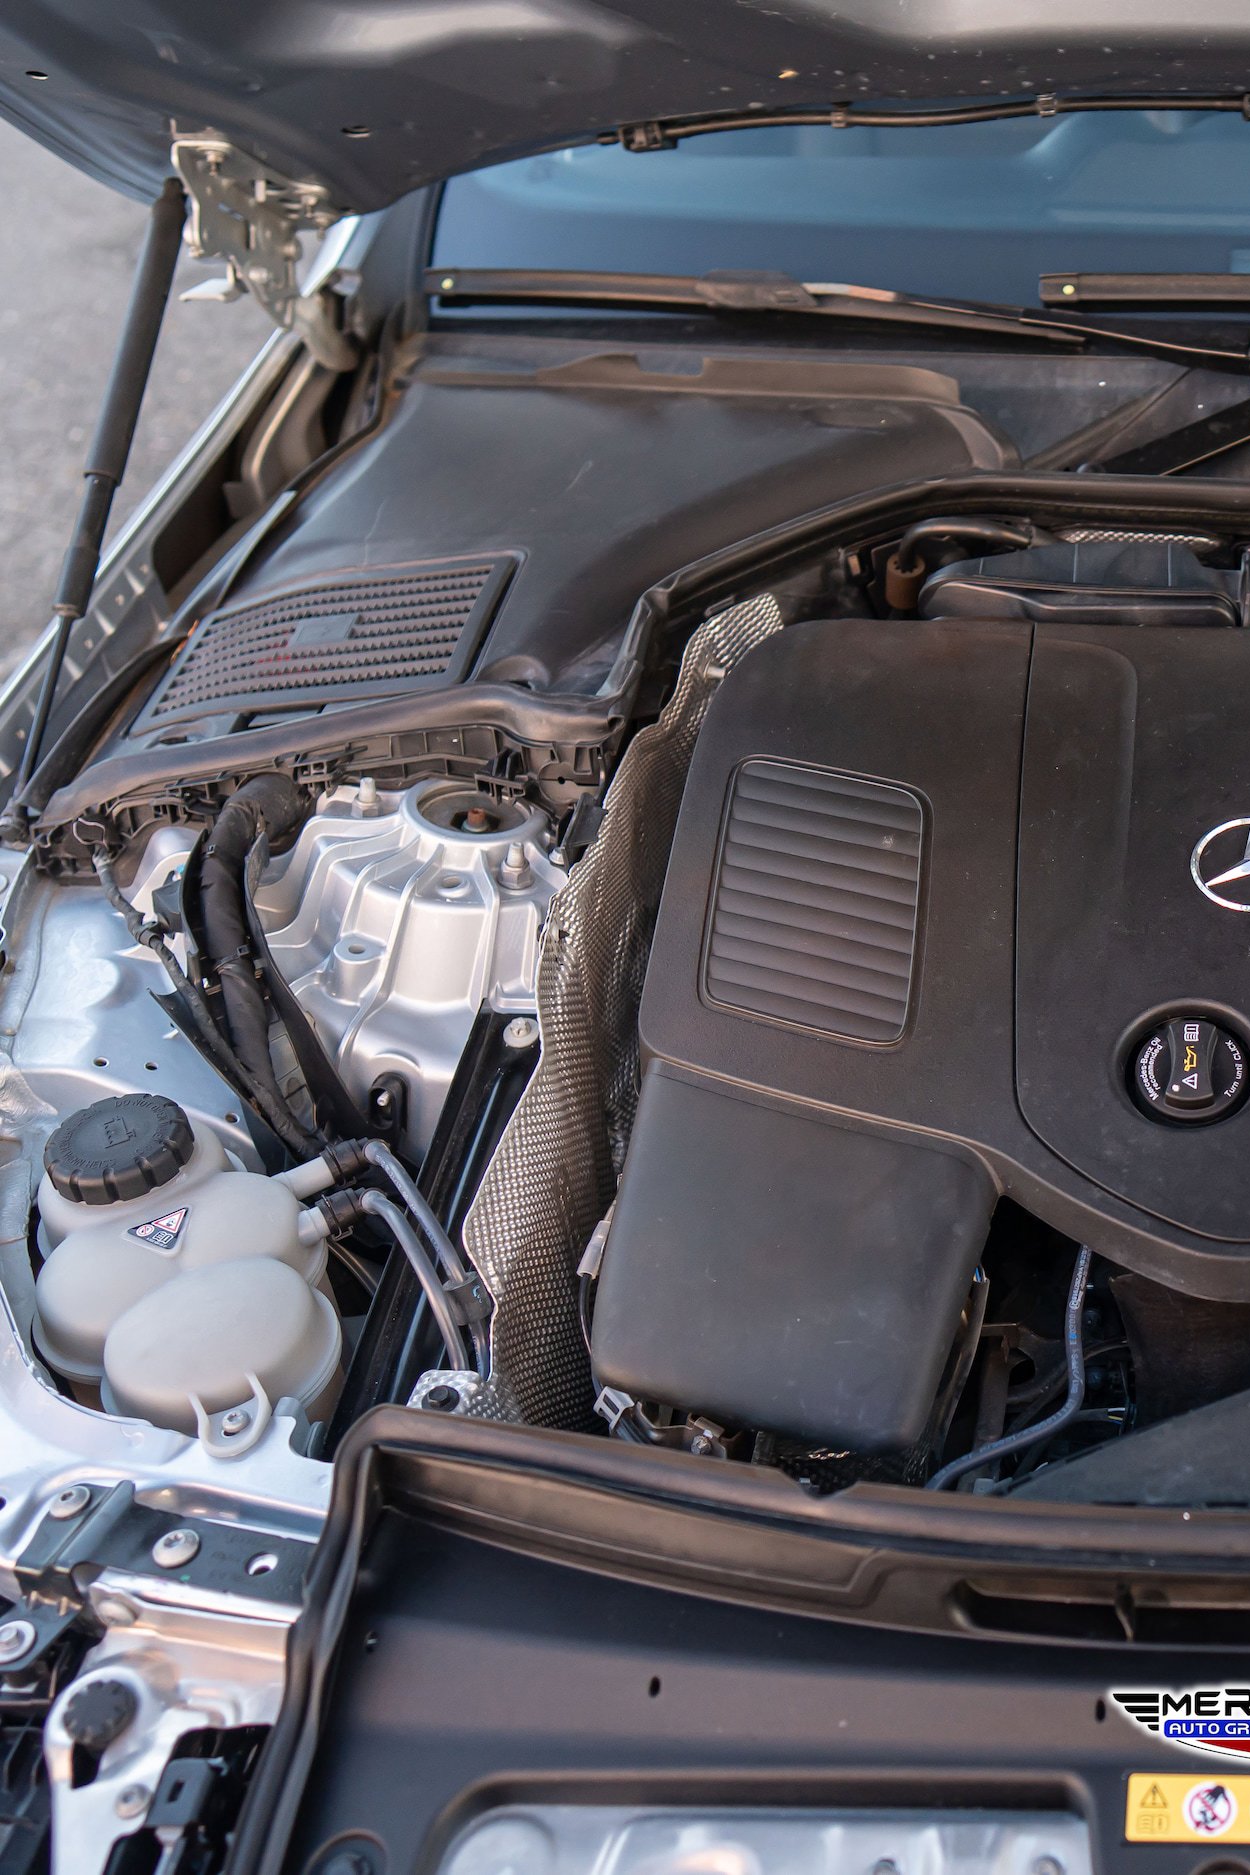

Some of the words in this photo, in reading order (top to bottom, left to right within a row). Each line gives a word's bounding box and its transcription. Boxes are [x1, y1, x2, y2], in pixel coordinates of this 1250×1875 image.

[1225, 1039, 1242, 1061] CLICK
[1139, 1046, 1159, 1101] Mercedes-Benz
[1151, 1036, 1162, 1047] Oil
[1147, 1043, 1163, 1091] recommended
[1235, 1063, 1243, 1080] until
[1223, 1080, 1240, 1098] Turn
